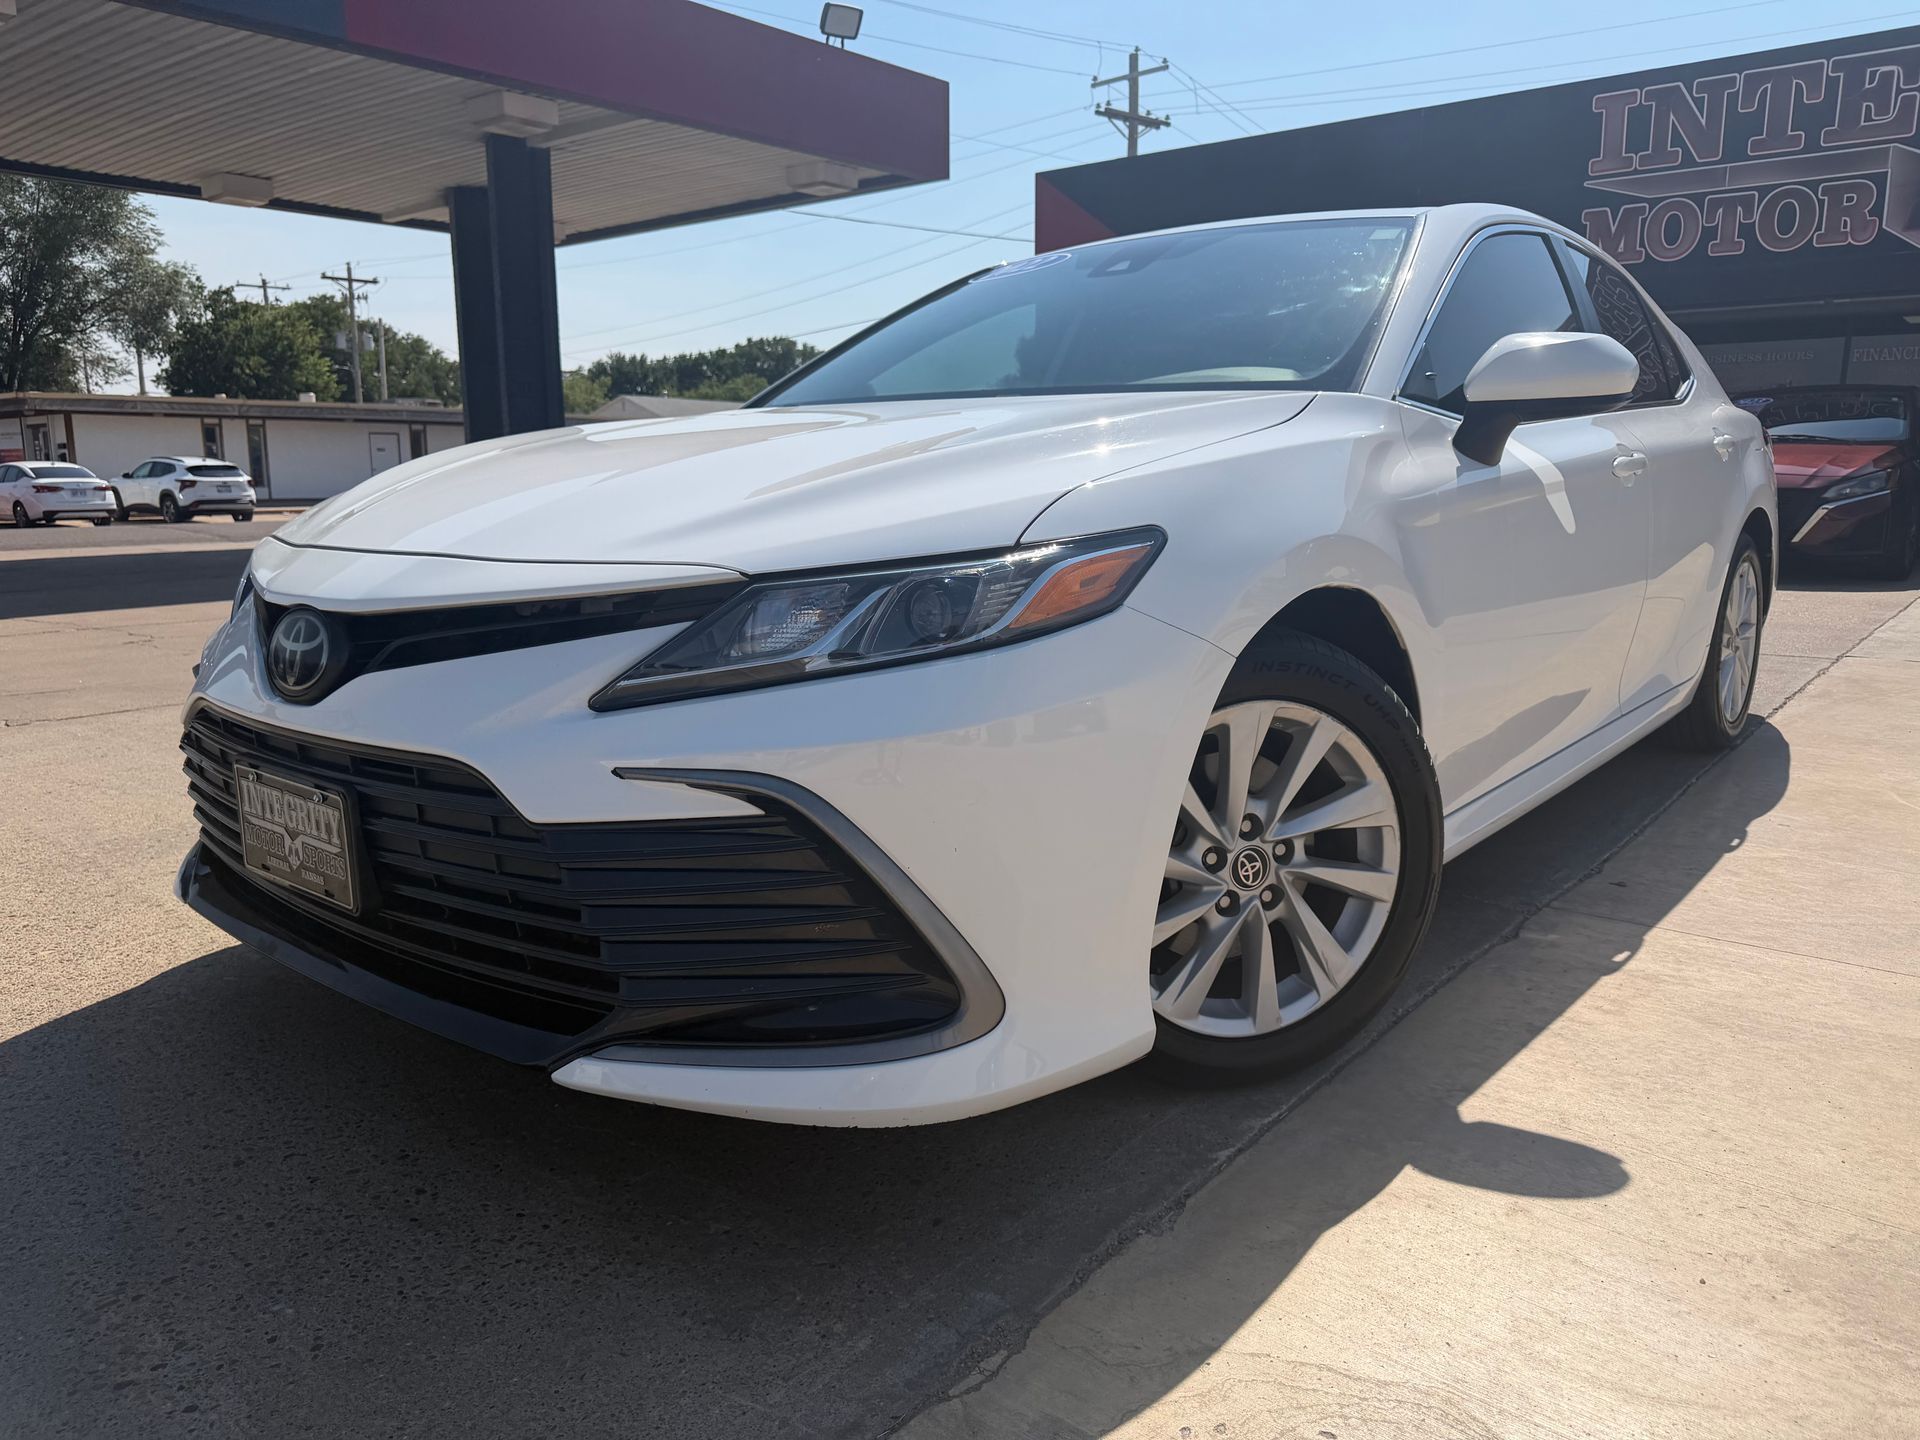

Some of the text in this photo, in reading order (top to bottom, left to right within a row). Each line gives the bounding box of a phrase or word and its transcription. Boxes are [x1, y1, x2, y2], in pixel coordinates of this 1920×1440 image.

[1582, 179, 1879, 264] MOTOR
[1704, 350, 1815, 363] USINESS HOURS
[1251, 660, 1357, 690] INSTINCT
[1363, 693, 1400, 731] UHP
[240, 780, 342, 847] INTEGRITY
[244, 822, 347, 880] MOTOR SPORTS
